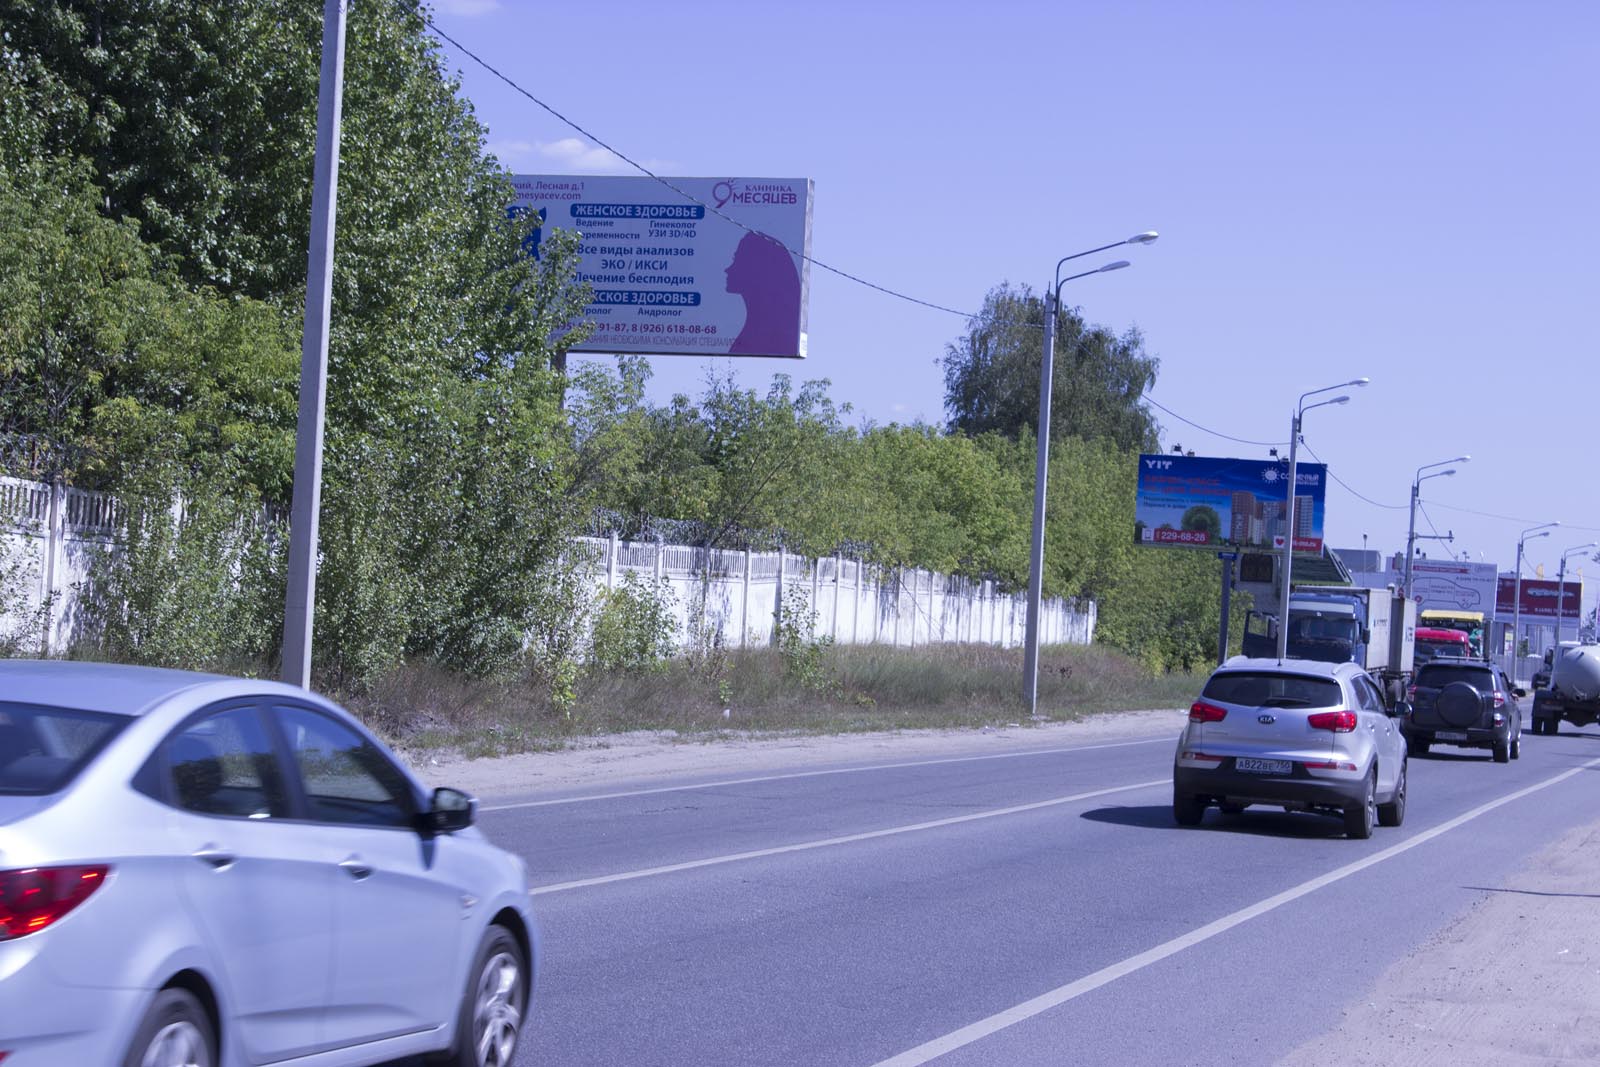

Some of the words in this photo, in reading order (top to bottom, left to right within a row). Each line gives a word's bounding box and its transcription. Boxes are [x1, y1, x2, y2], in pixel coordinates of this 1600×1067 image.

[536, 182, 569, 190] Лесная
[514, 191, 581, 201] mesyacev.com
[733, 193, 797, 204] МЕСЯЦЕВ
[576, 206, 632, 216] ЖЕНСКОЕ
[635, 207, 697, 218] ЗДОРОВЬЕ
[576, 219, 614, 227] Ведение
[650, 221, 696, 229] Гинеколог
[580, 231, 640, 240] еременности
[669, 230, 697, 238] 3D/4D
[601, 245, 633, 256] виды
[637, 246, 694, 256] анализов
[601, 259, 625, 269] ЭКО
[635, 260, 667, 270] ИКСИ
[575, 272, 625, 283] Лечение
[628, 273, 694, 286] бесплодия
[632, 292, 694, 304] ЗДОРОВЬЕ
[638, 307, 682, 317] Андролог
[640, 324, 665, 334] (926)
[667, 325, 717, 334] 618-08-68
[1145, 460, 1172, 469] YIT
